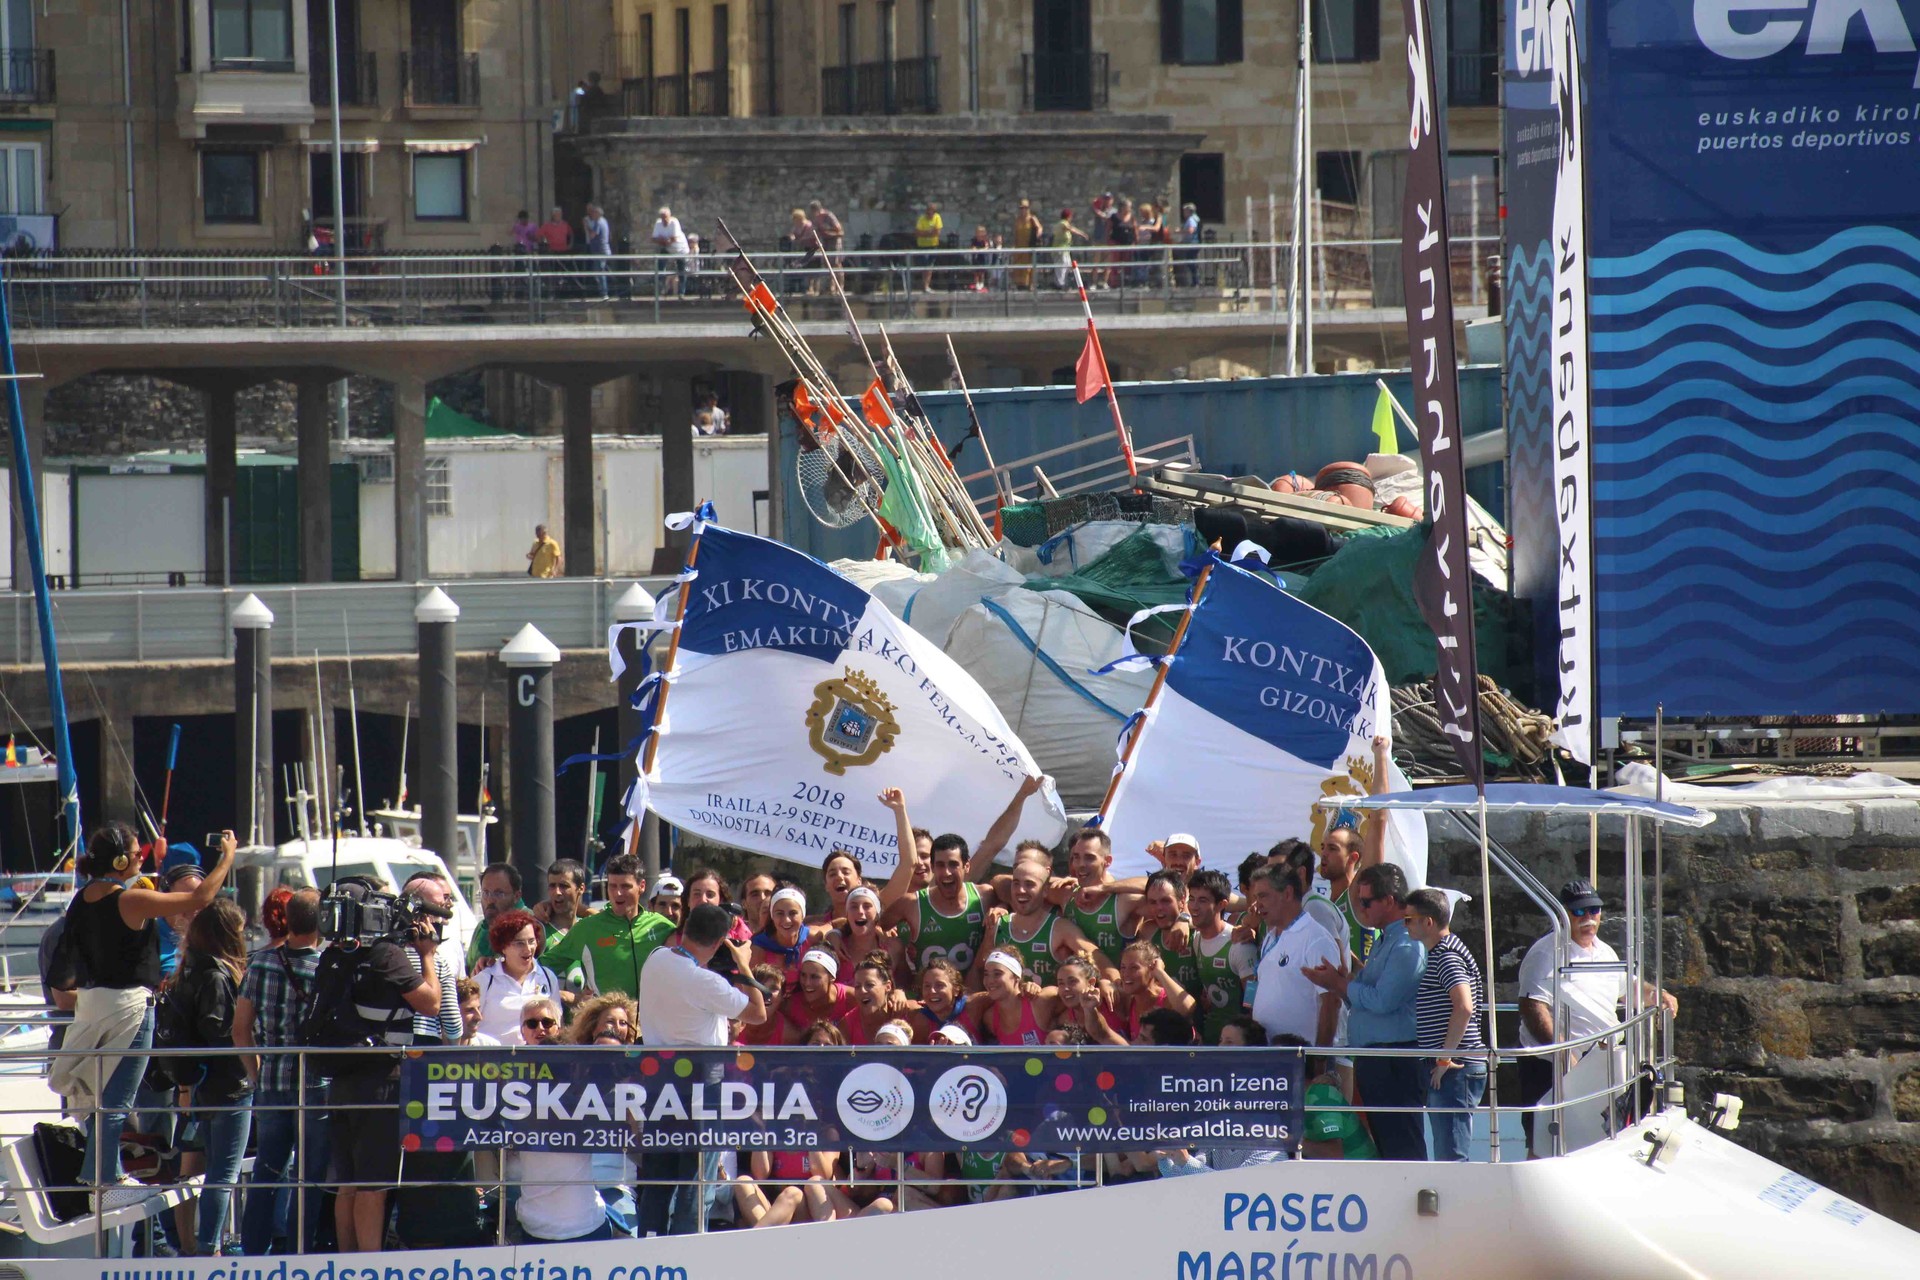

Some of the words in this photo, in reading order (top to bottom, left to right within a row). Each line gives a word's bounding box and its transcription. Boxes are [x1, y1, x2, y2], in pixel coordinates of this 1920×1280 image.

[1698, 106, 1840, 126] euskadiko
[1697, 132, 1784, 154] puertos
[1791, 129, 1911, 151] deportivos
[702, 581, 734, 613] XI
[635, 628, 648, 650] B
[1222, 635, 1378, 711] KONTXAK
[518, 674, 535, 706] C
[793, 781, 845, 810] 2018
[707, 793, 768, 815] IRAILA
[772, 803, 798, 819] 2-9
[800, 810, 898, 848] SEPTIEMB
[689, 808, 772, 837] DONOSTIA
[776, 825, 784, 838] /
[785, 827, 829, 850] SAN
[829, 841, 900, 867] SEBAST
[427, 1063, 554, 1081] DONOSTIA
[1161, 1075, 1223, 1093] Eman
[1230, 1073, 1288, 1092] izena
[427, 1081, 818, 1122] EUSKARALDIA
[1129, 1099, 1190, 1112] irailaren
[1193, 1098, 1231, 1112] 20tik
[1234, 1099, 1288, 1111] aurrera
[463, 1128, 576, 1146] Azaroaren
[582, 1128, 636, 1148] 23tik
[641, 1128, 777, 1146] abenduaren
[783, 1128, 818, 1146] 3ra
[1056, 1119, 1289, 1141] www.euskaraldia.eus
[1223, 1193, 1368, 1233] PASEO
[1177, 1238, 1413, 1280] MARÍTIMO
